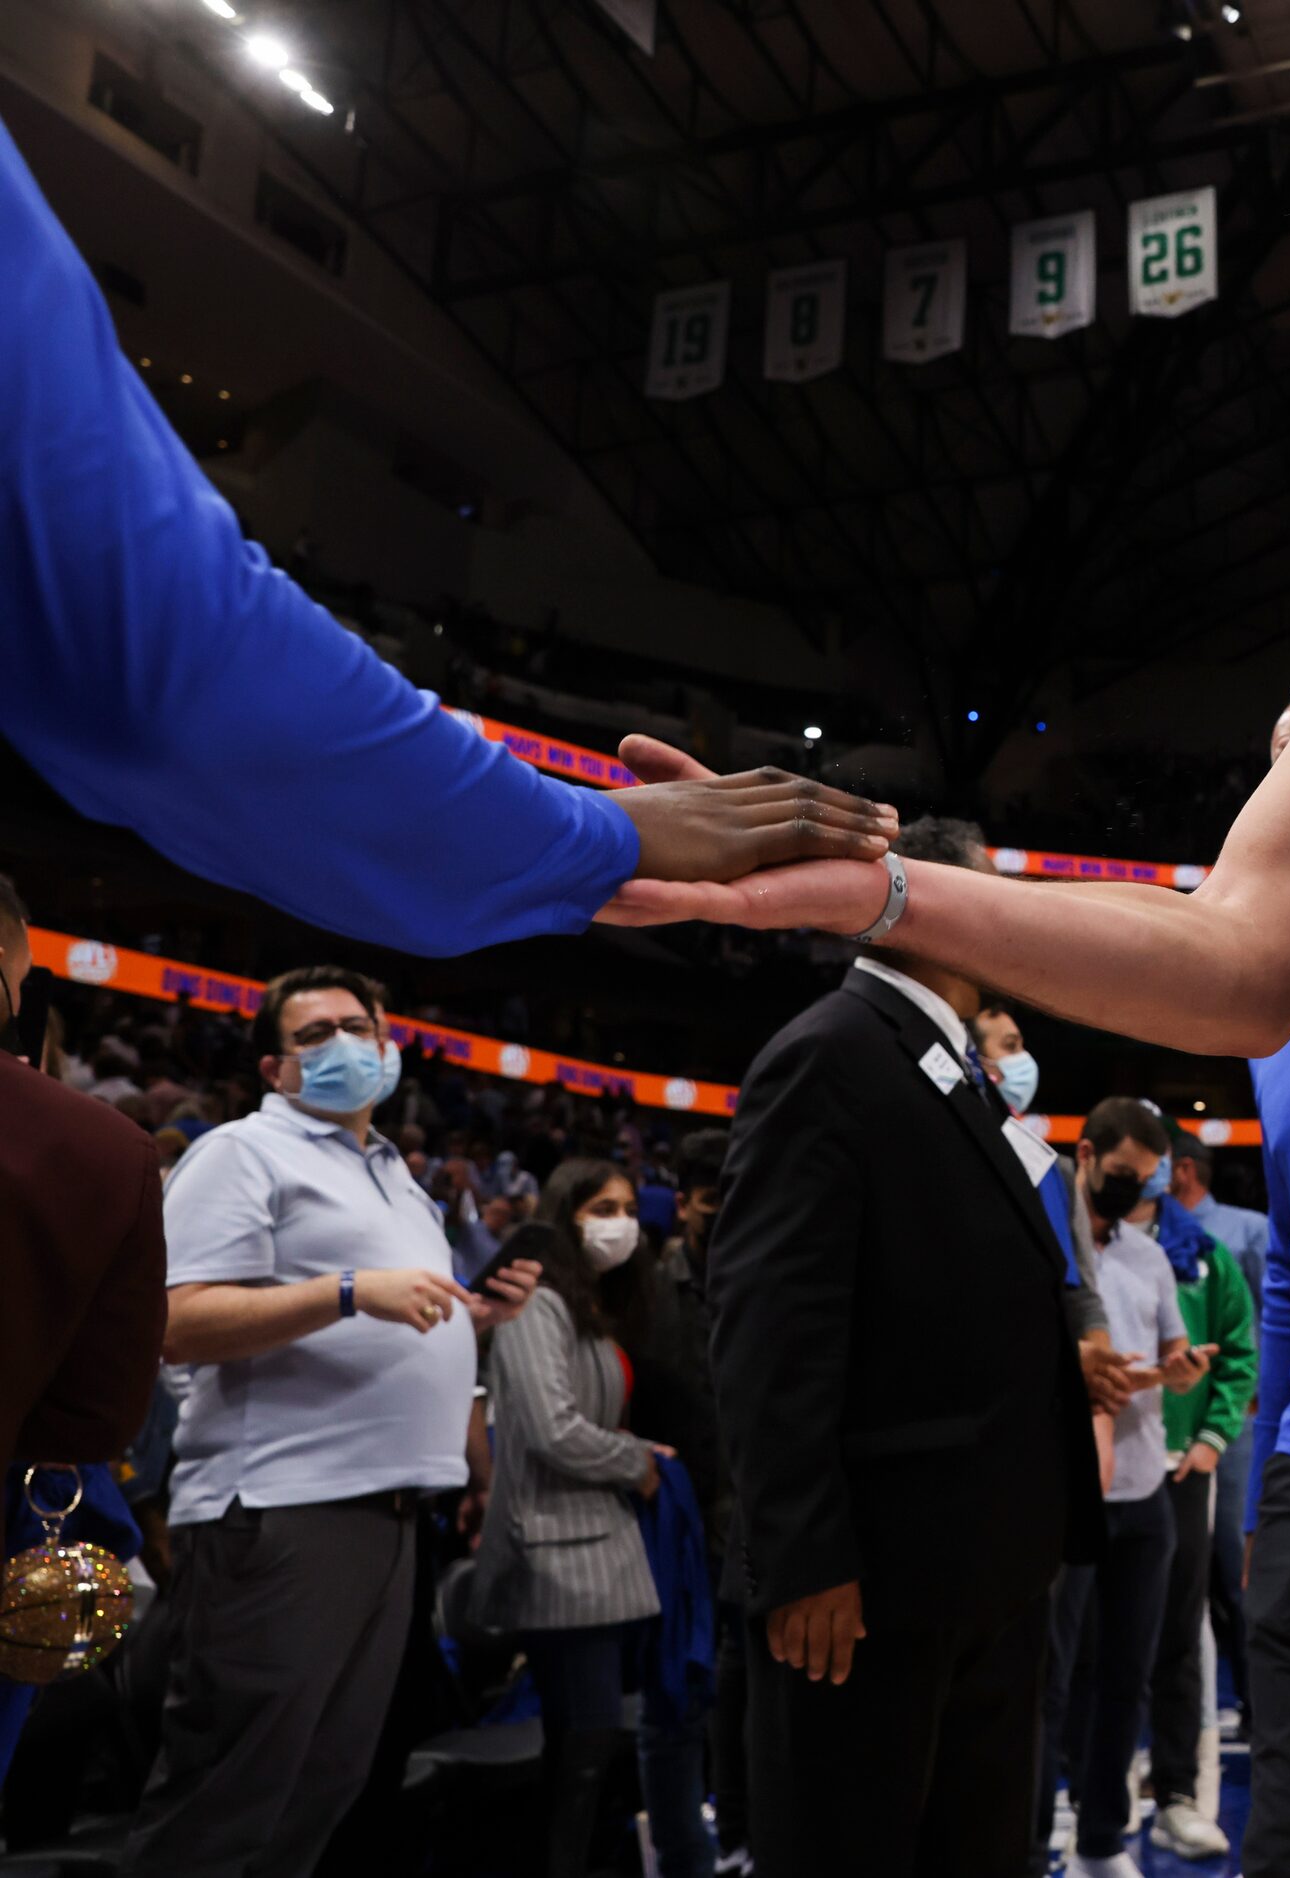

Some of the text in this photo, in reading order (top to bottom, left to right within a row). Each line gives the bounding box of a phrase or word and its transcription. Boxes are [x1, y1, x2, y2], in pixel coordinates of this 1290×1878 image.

[1038, 251, 1065, 304] 9
[1142, 225, 1203, 285] 26
[792, 295, 817, 345] 8
[912, 273, 937, 327] 7
[664, 314, 708, 366] 19
